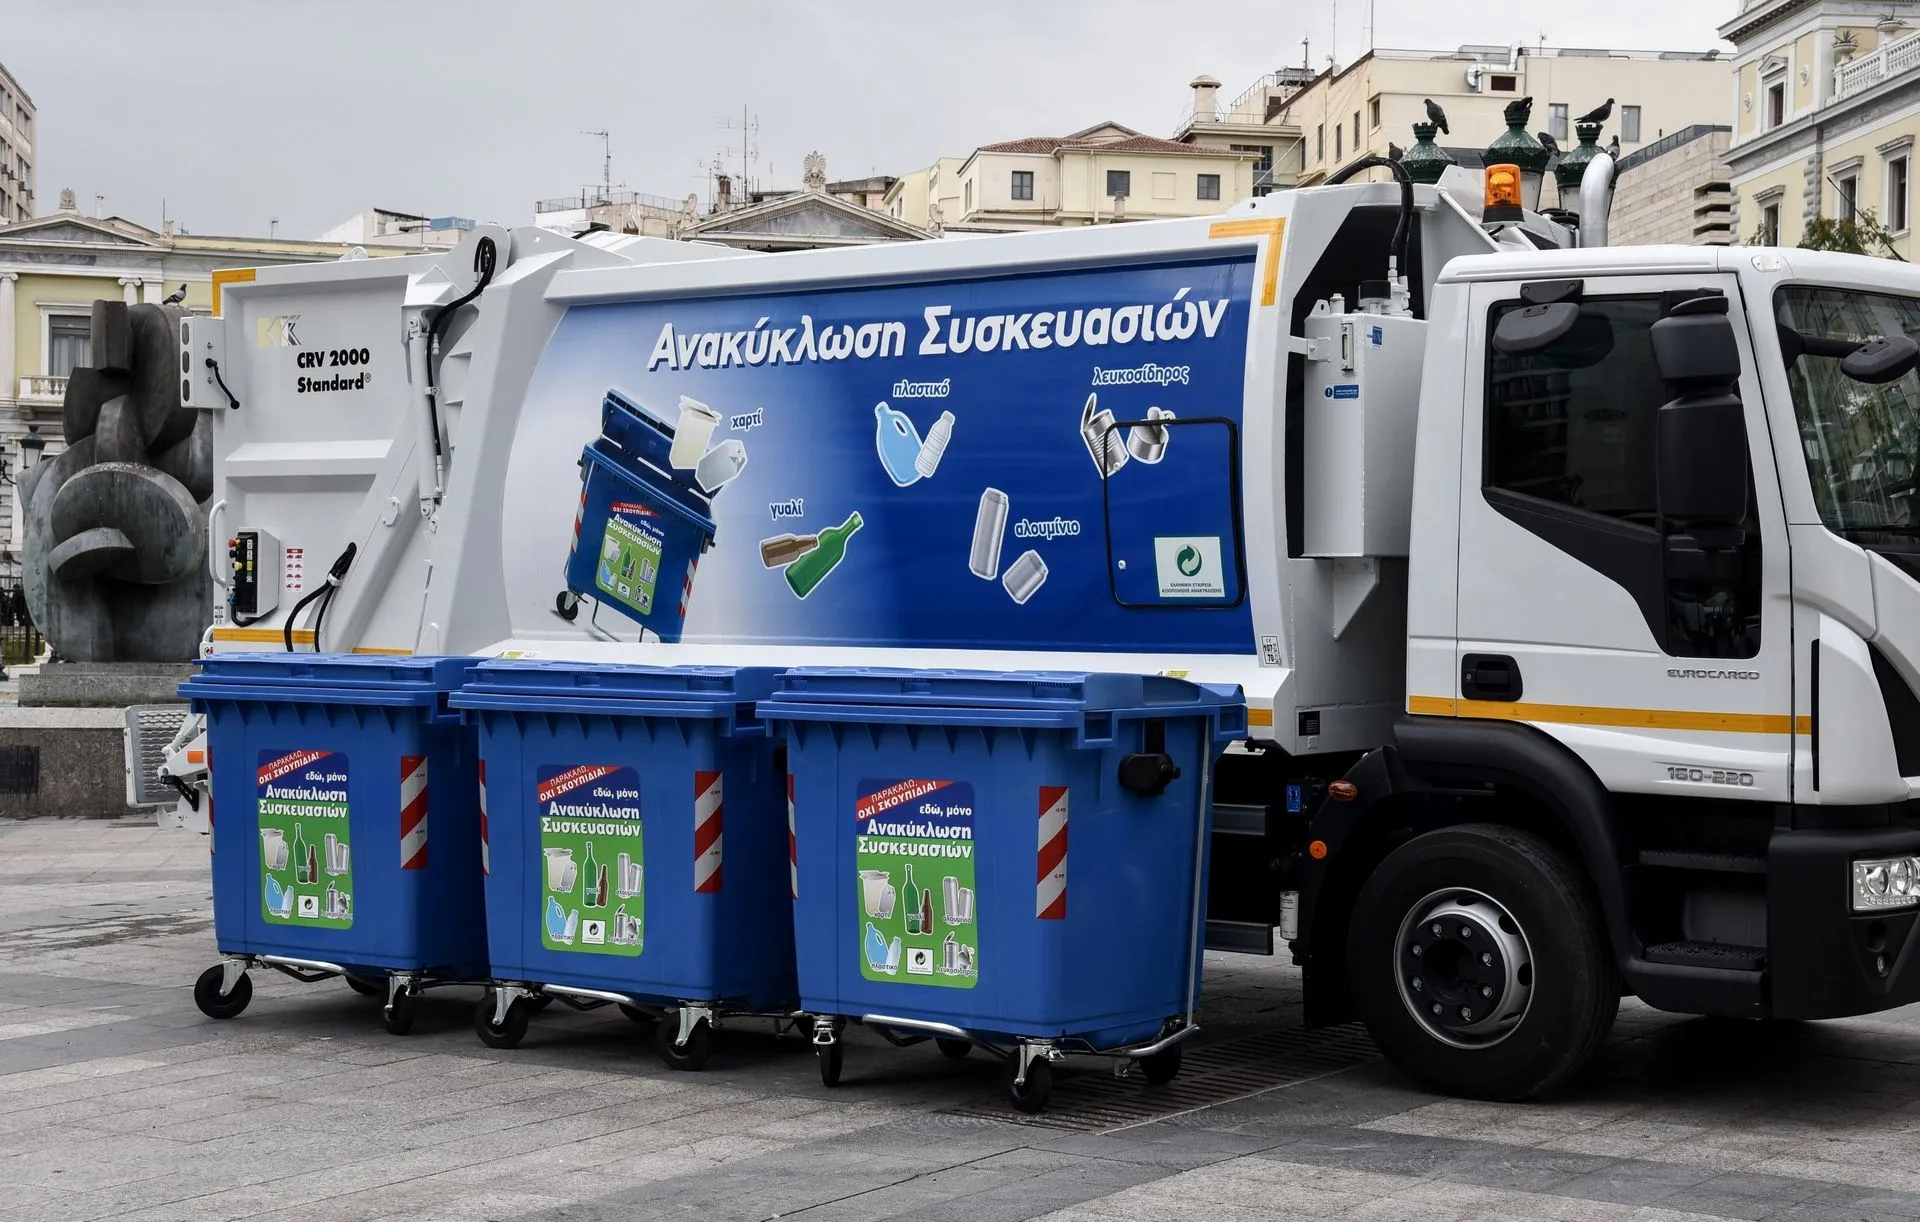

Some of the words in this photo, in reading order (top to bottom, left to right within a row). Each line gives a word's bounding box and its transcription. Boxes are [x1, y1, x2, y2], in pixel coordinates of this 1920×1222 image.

[647, 314, 906, 371] Ανακύκλωση
[918, 287, 1230, 356] Συσκευασιών
[296, 351, 326, 369] CRV
[329, 347, 370, 367] 2000
[1092, 364, 1190, 385] λευκοσίδηρος
[892, 379, 950, 398] πλαστικό
[730, 408, 763, 432] χαρτί
[770, 499, 804, 520] γυαλί
[1014, 517, 1081, 540] αλουμίνιο
[1667, 669, 1760, 680] EUROCARGO
[259, 773, 272, 784] ΟΧΙ
[274, 751, 320, 777] ΣΚΟΥΠΙΔΙΑ!
[305, 771, 325, 783] εδώ,
[326, 772, 347, 783] μόνο
[265, 784, 347, 802] Ανακύκλωση
[540, 789, 555, 801] ΟΧΙ
[556, 766, 606, 794] ΣΚΟΥΠΙΔΙΑ!
[593, 787, 614, 799] εδώ,
[616, 788, 639, 799] μόνο
[259, 799, 347, 818] Συσκευασιών
[549, 801, 640, 819] Ανακύκλωση
[858, 806, 875, 819] ΟΧΙ
[878, 781, 937, 811] ΣΚΟΥΠΙΔΙΑ!
[919, 804, 943, 817] εδώ,
[946, 805, 972, 817] μόνο
[542, 817, 640, 836] Συσκευασιών
[866, 818, 972, 839] Ανακύκλωση
[858, 836, 972, 858] Συσκευασιών
